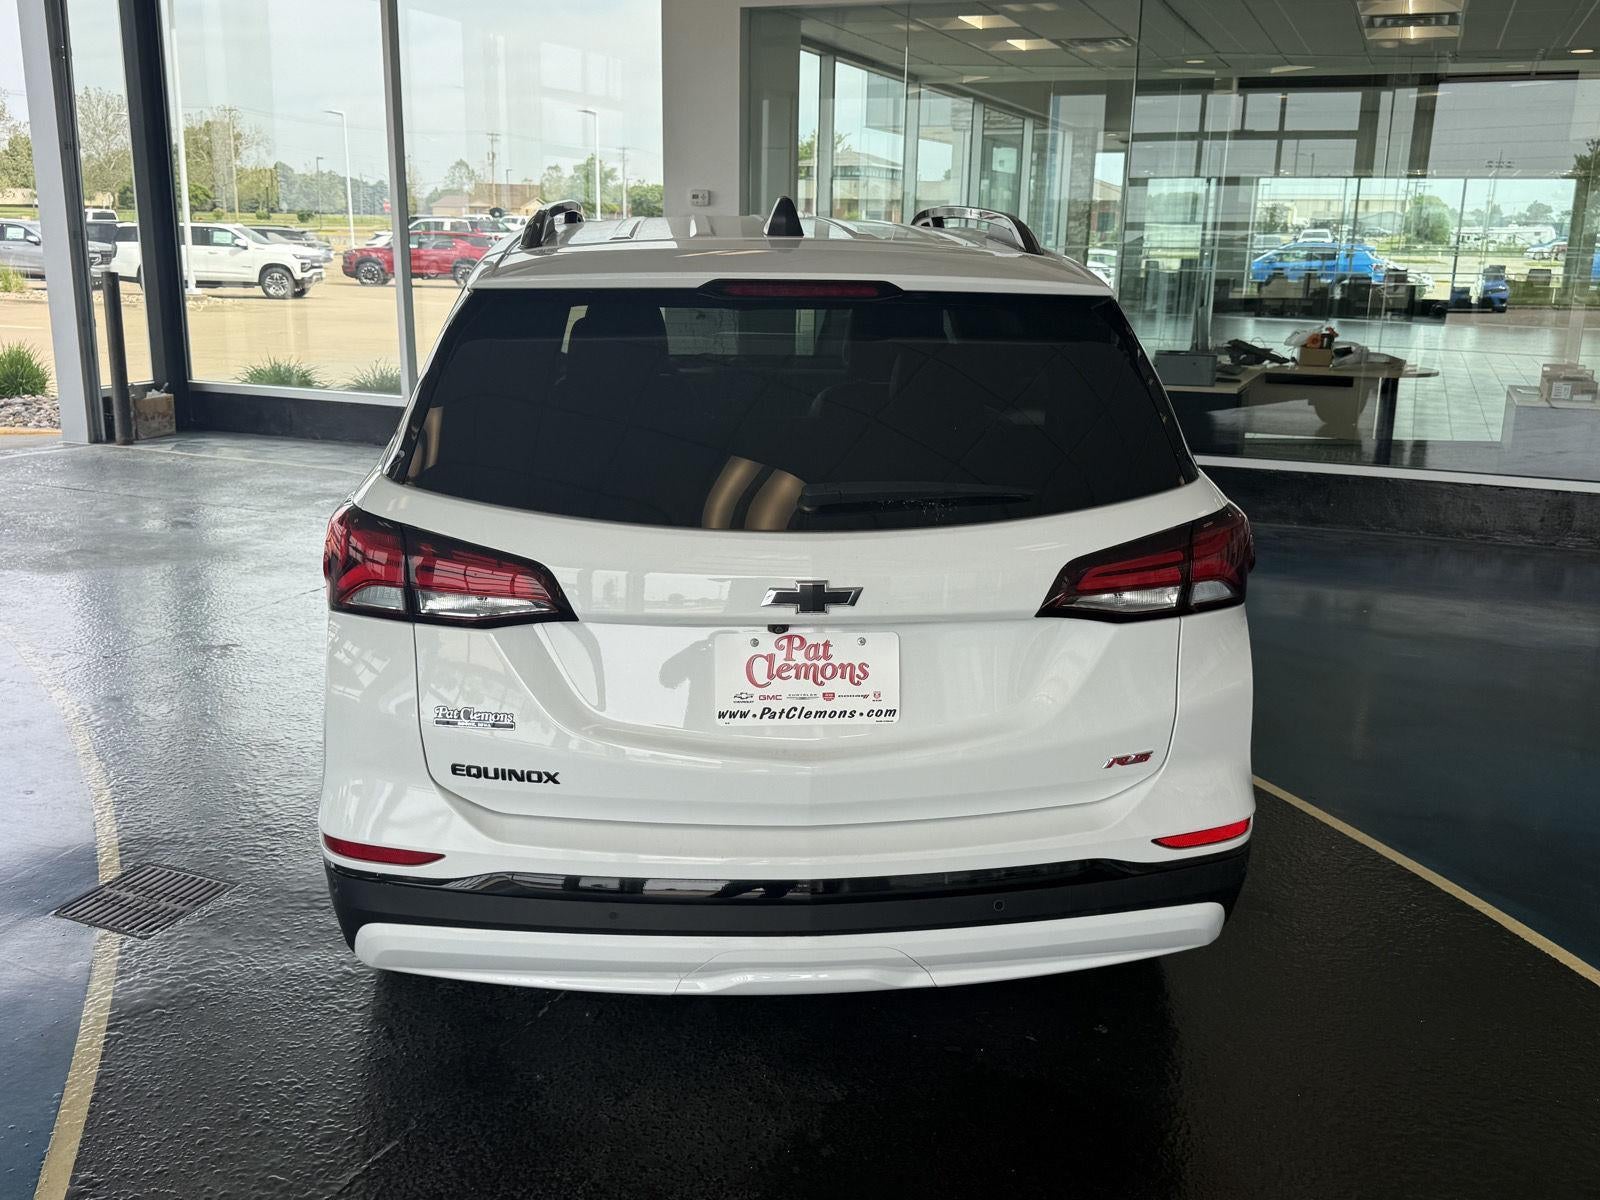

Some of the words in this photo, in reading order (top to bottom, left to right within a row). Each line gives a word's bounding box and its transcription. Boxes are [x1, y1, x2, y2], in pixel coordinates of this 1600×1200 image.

[774, 634, 834, 662] Pat
[745, 653, 870, 688] Clemons
[434, 706, 460, 719] Pat
[460, 707, 514, 723] Clemons
[1102, 750, 1154, 769] RS
[450, 763, 561, 785] EQUINOX
